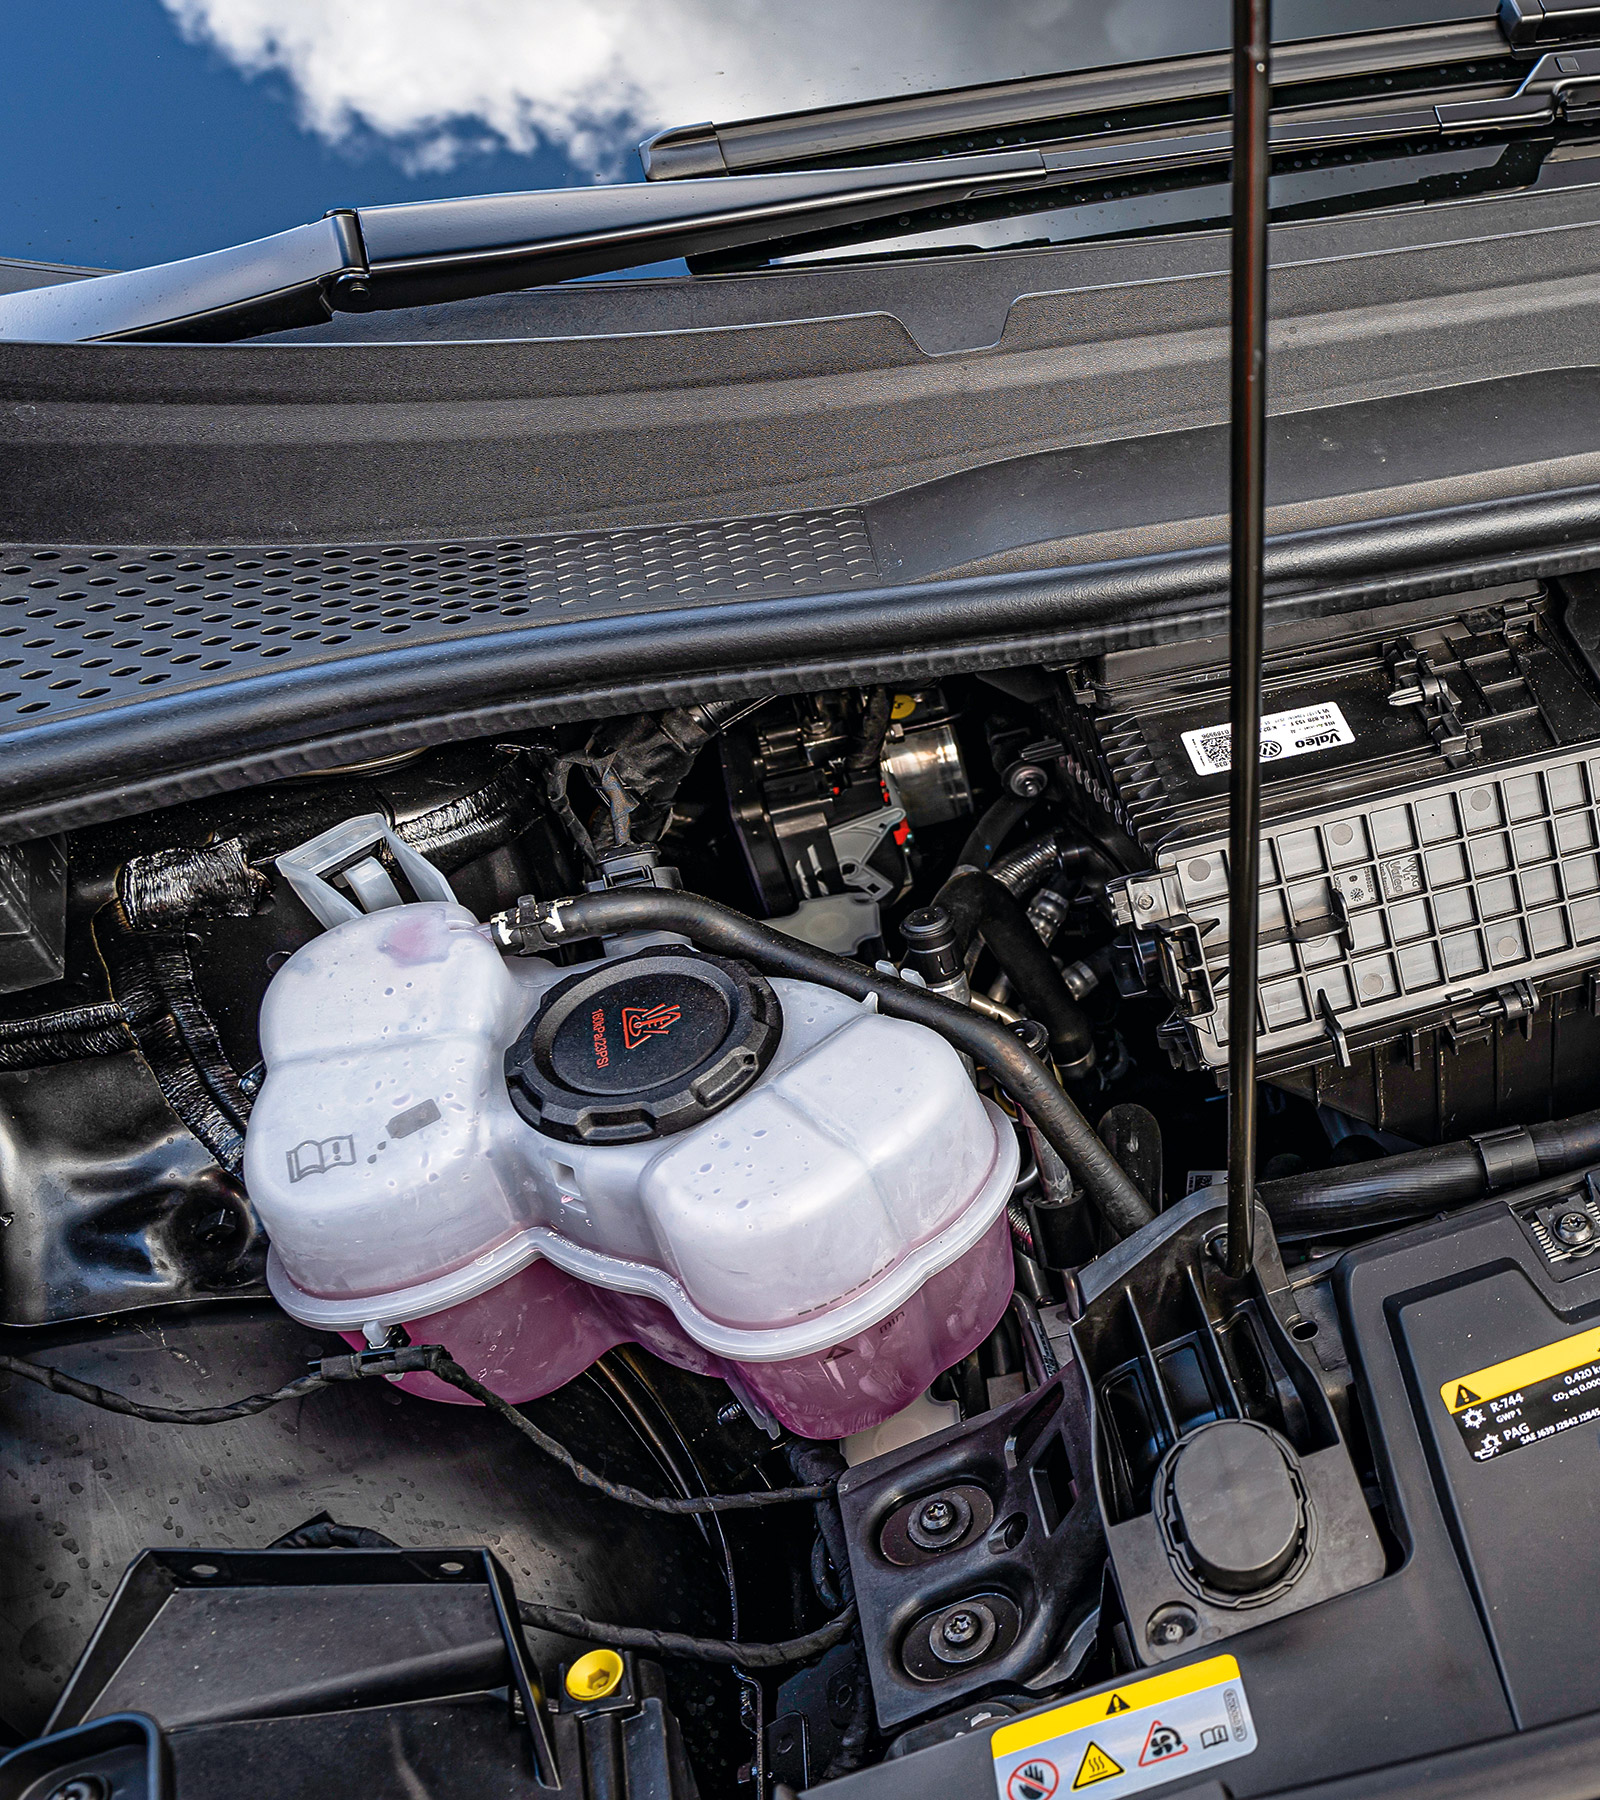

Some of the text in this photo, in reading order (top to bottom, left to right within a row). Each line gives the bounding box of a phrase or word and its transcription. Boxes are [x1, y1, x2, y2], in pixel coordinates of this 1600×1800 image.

[1294, 733, 1342, 748] Valeo
[1389, 860, 1404, 893] Valeo
[879, 1311, 905, 1334] min
[1564, 1368, 1593, 1385] 0.420
[1568, 1387, 1581, 1396] eq
[1490, 1392, 1524, 1413] R-744
[1495, 1408, 1522, 1424] GWP 1
[1503, 1422, 1530, 1440] PAG
[1519, 1432, 1537, 1445] SAE
[1555, 1416, 1579, 1432] J2842
